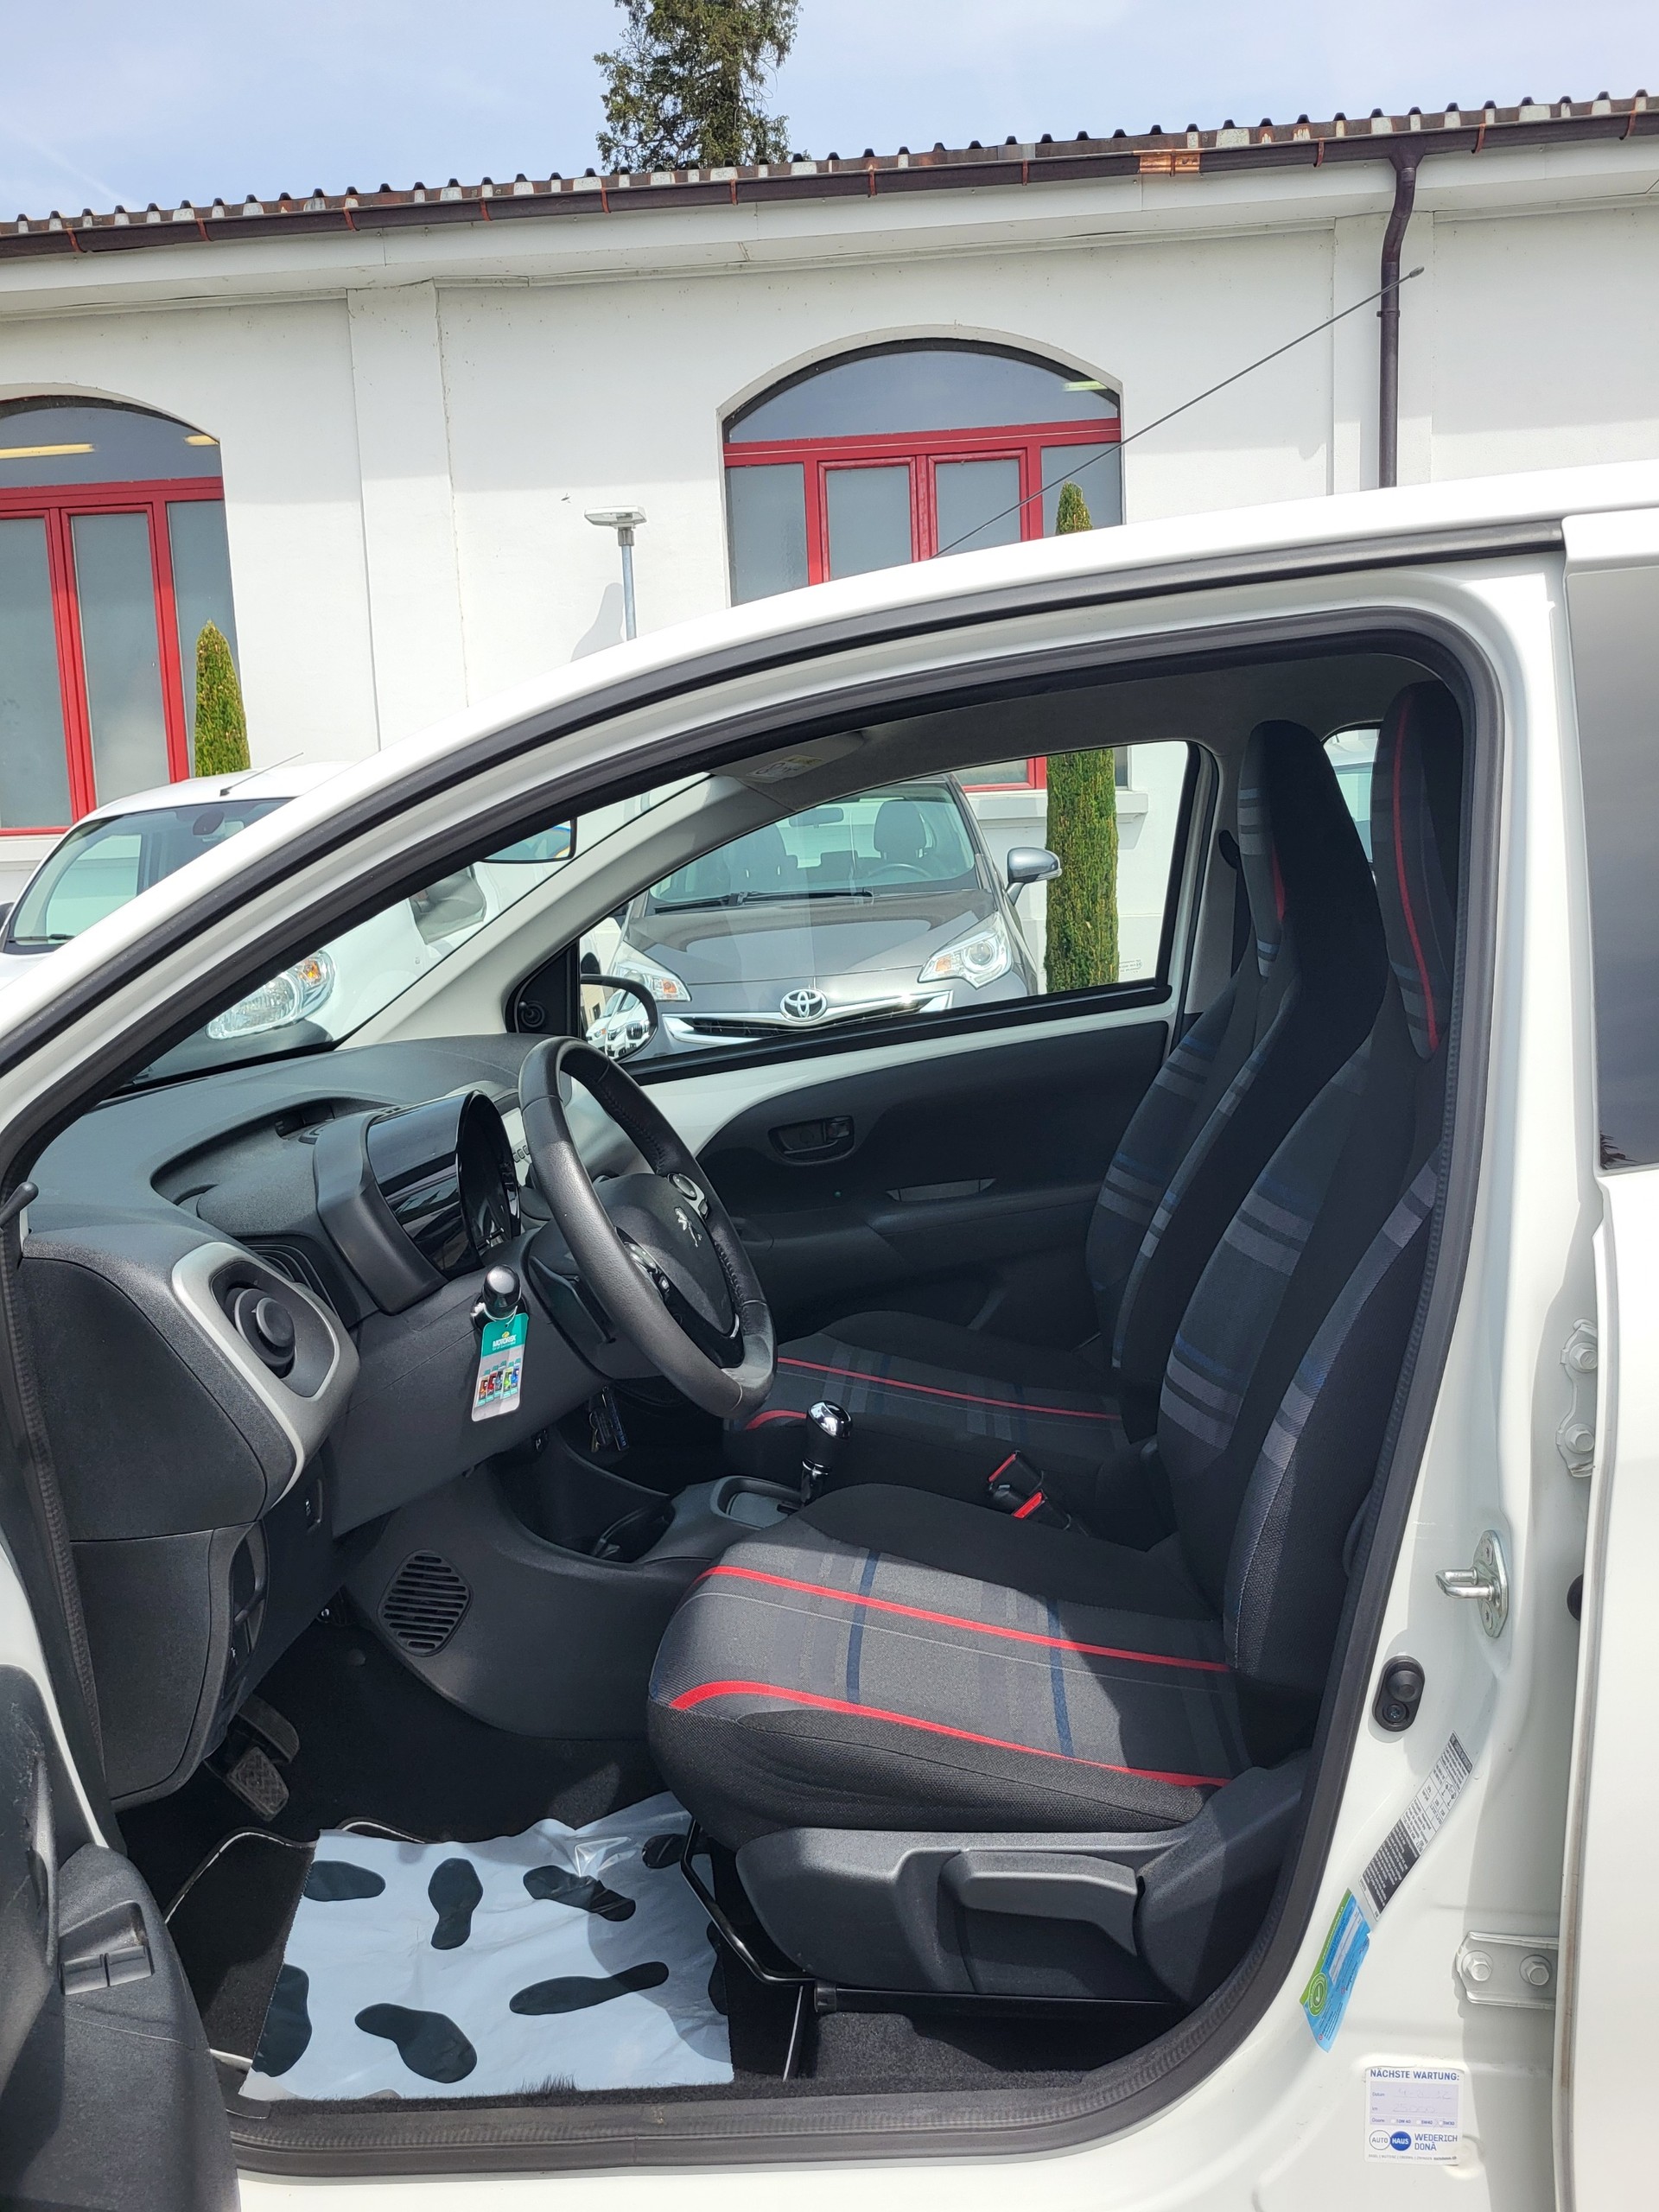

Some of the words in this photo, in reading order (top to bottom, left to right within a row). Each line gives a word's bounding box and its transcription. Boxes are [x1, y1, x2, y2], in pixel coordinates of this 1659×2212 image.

[1370, 2068, 1410, 2079] NÄCHSTE
[1413, 2070, 1459, 2081] WARTUNG:
[1414, 2133, 1459, 2142] WEDERICH
